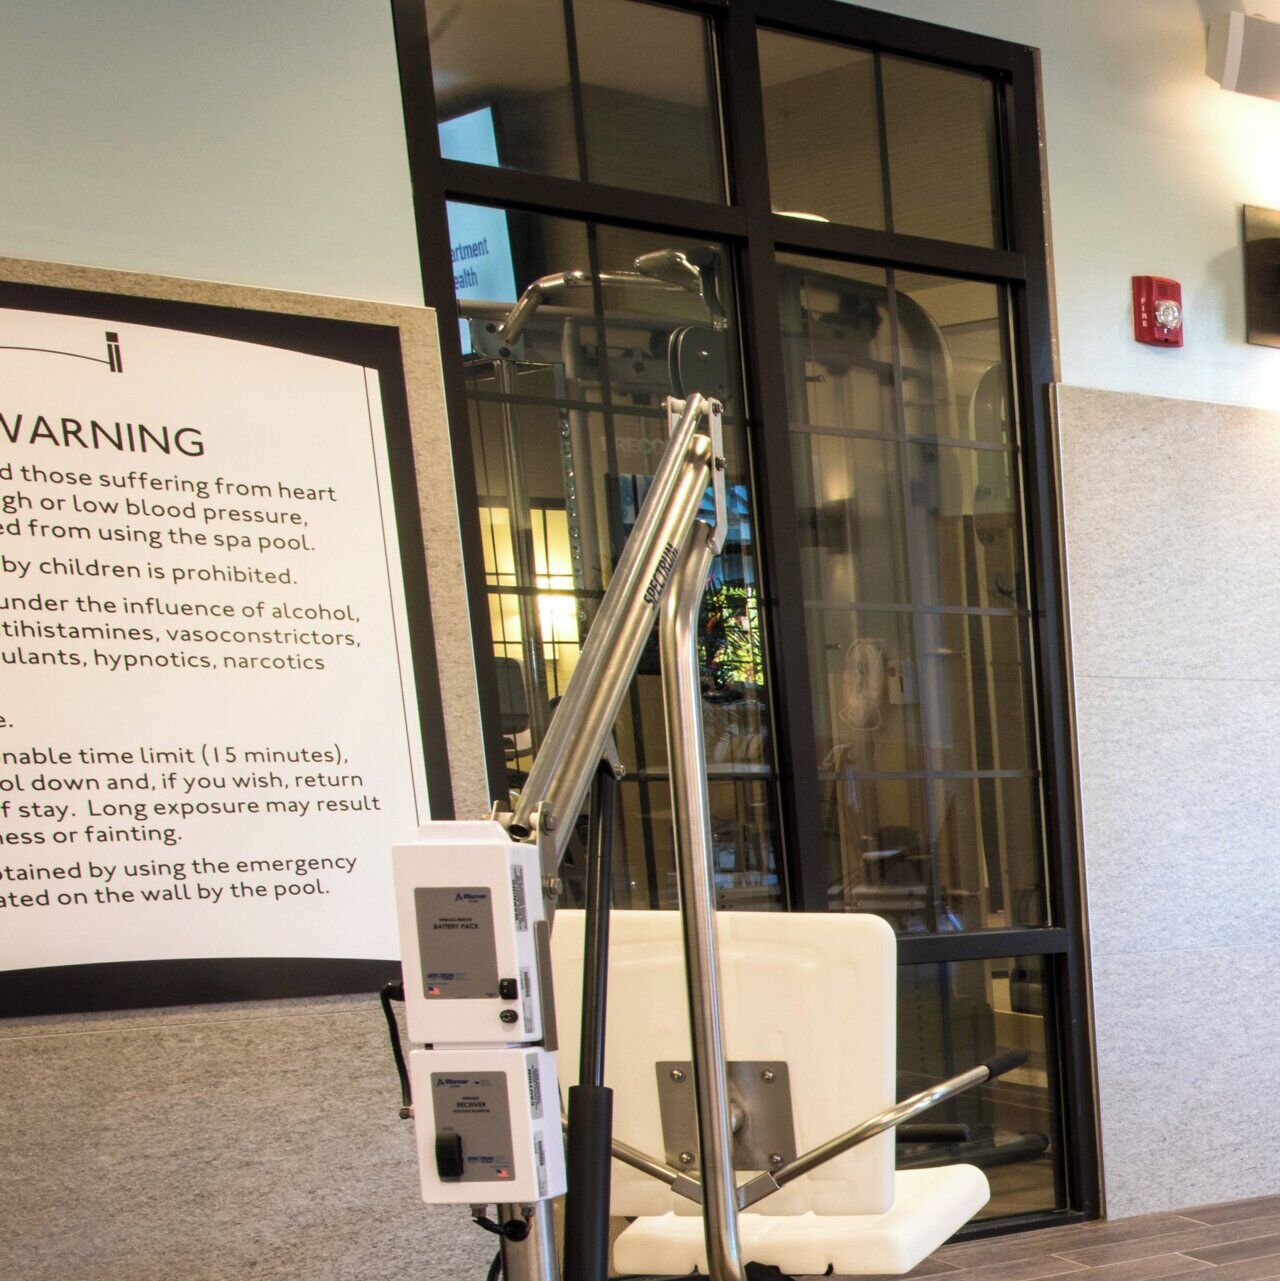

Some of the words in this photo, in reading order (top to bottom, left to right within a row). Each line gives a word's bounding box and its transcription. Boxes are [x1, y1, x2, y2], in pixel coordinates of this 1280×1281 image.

[1140, 297, 1148, 327] FIRE
[19, 464, 93, 486] those
[98, 470, 210, 500] suffering
[214, 476, 272, 498] from
[277, 481, 337, 502] heart
[39, 497, 67, 511] or
[72, 494, 119, 515] low
[125, 497, 196, 519] blood
[203, 507, 308, 527] pressure,
[27, 518, 92, 540] from
[98, 524, 163, 550] using
[167, 527, 207, 546] the
[213, 534, 252, 552] spa
[258, 533, 315, 554] pool.
[1, 554, 31, 579] by
[39, 556, 141, 579] children
[146, 562, 166, 580] is
[172, 564, 297, 585] prohibited.
[643, 542, 680, 611] SPECTRUM
[0, 593, 70, 612] under
[75, 595, 117, 614] the
[122, 596, 235, 618] influence
[241, 601, 265, 618] of
[271, 602, 360, 623] alcohol,
[165, 628, 361, 648] vasoconstrictors,
[93, 648, 217, 672] hypnotics,
[223, 653, 325, 670] narcotics
[2, 746, 73, 765] nable
[77, 747, 135, 765] time
[139, 746, 196, 764] limit
[244, 743, 348, 766] minutes),
[31, 773, 100, 792] down
[107, 772, 156, 792] and,
[161, 772, 177, 790] if
[182, 776, 226, 795] you
[231, 771, 289, 790] wish,
[294, 772, 364, 788] return
[18, 802, 76, 823] stay.
[87, 799, 149, 822] Long
[153, 801, 260, 820] exposure
[265, 800, 310, 818] may
[316, 794, 382, 812] result
[52, 830, 79, 844] or
[84, 824, 182, 847] fainting.
[0, 861, 82, 882] tained
[88, 861, 117, 883] by
[123, 859, 187, 881] using
[191, 857, 230, 875] the
[236, 857, 357, 876] emergency
[57, 892, 89, 906] on
[93, 886, 135, 904] the
[140, 883, 192, 902] wall
[196, 882, 224, 904] by
[229, 881, 268, 898] the
[273, 878, 330, 901] pool.
[527, 1069, 535, 1107] CAUTION
